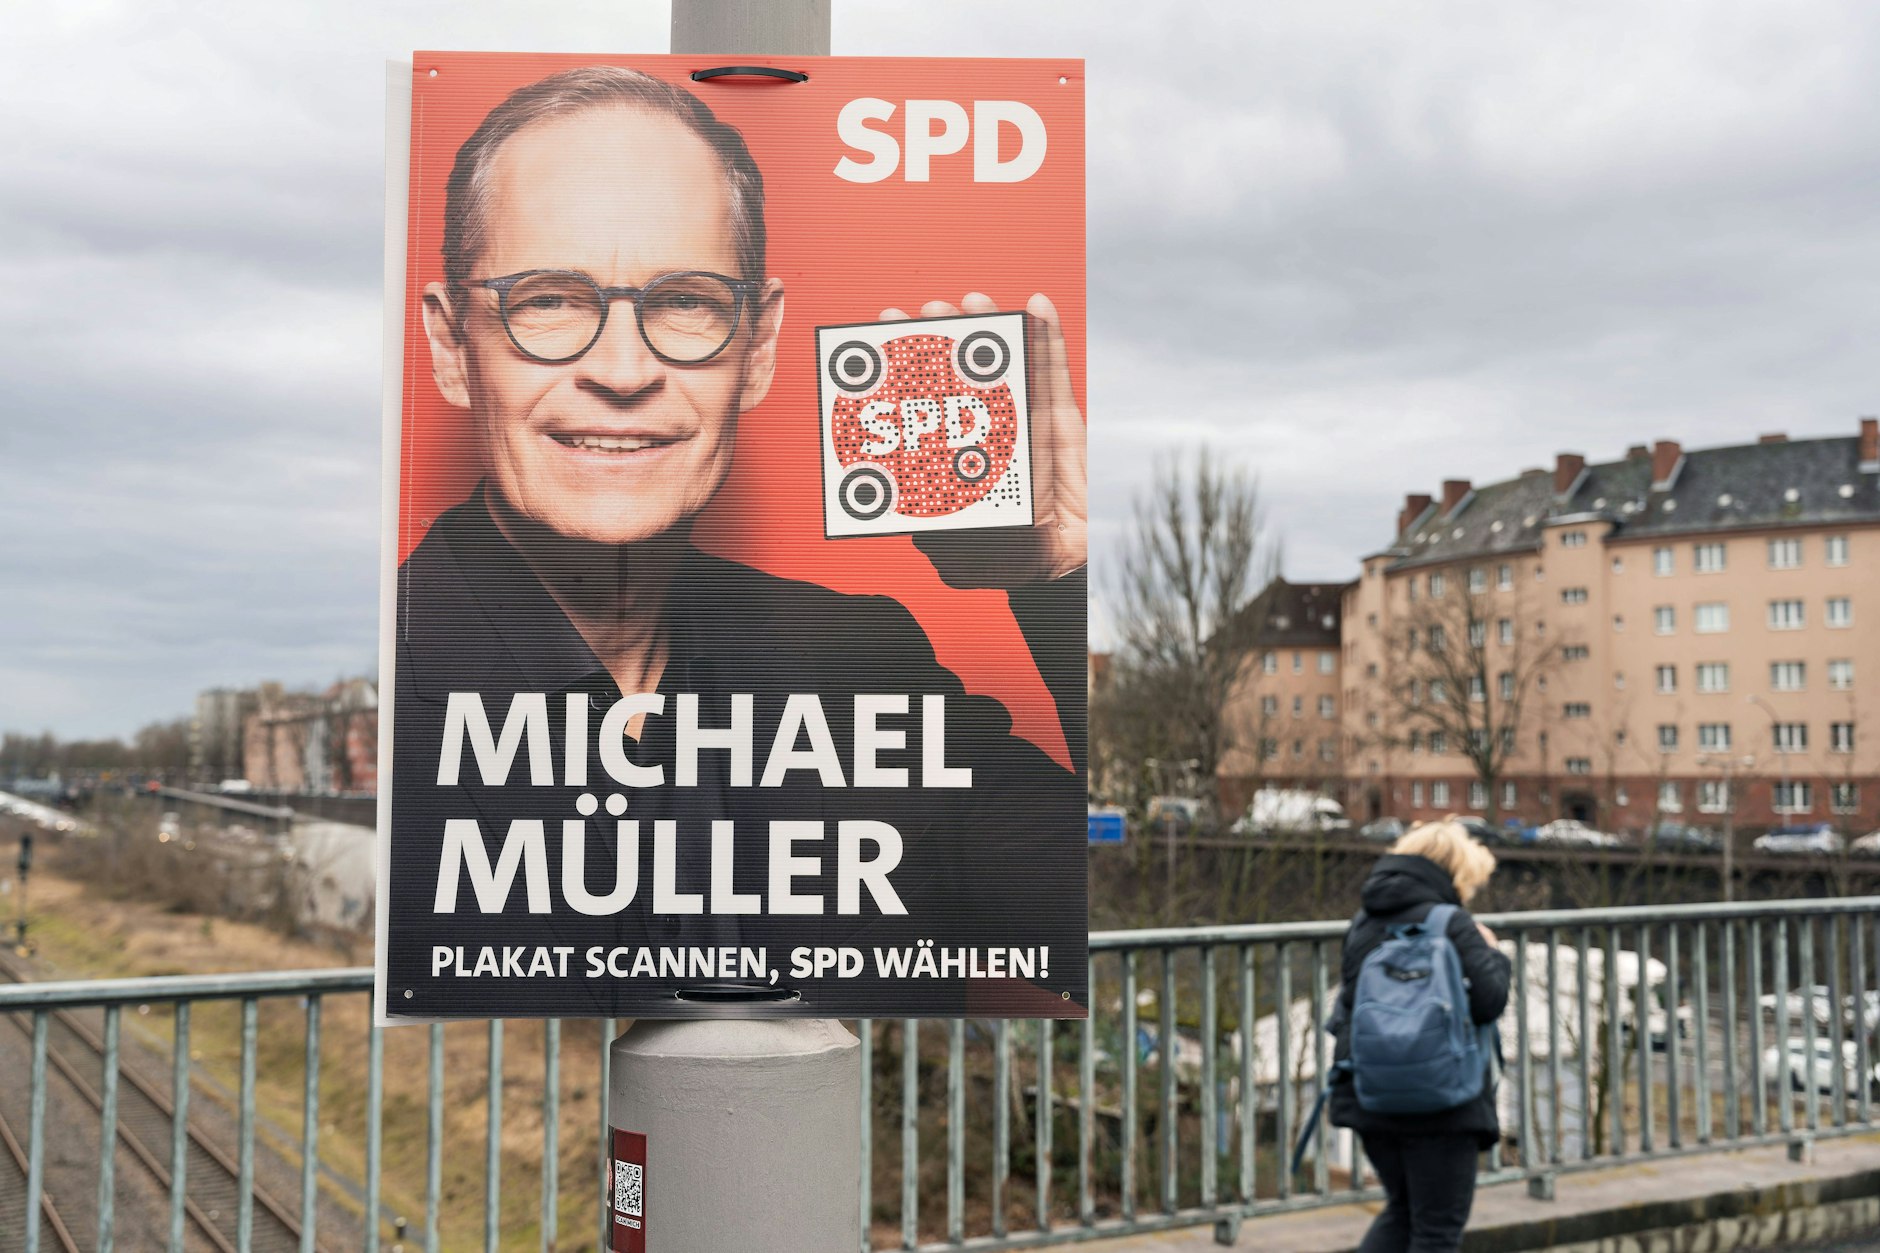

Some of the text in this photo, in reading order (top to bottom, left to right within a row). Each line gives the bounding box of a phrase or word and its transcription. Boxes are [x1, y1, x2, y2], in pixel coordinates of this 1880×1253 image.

[833, 97, 1048, 184] SPD
[859, 395, 991, 455] SPD
[436, 691, 973, 788] MICHAEL
[433, 793, 909, 916] MÜLLER
[431, 939, 1049, 986] PLAKAT SCANNEN, SPD WÄHLEN!
